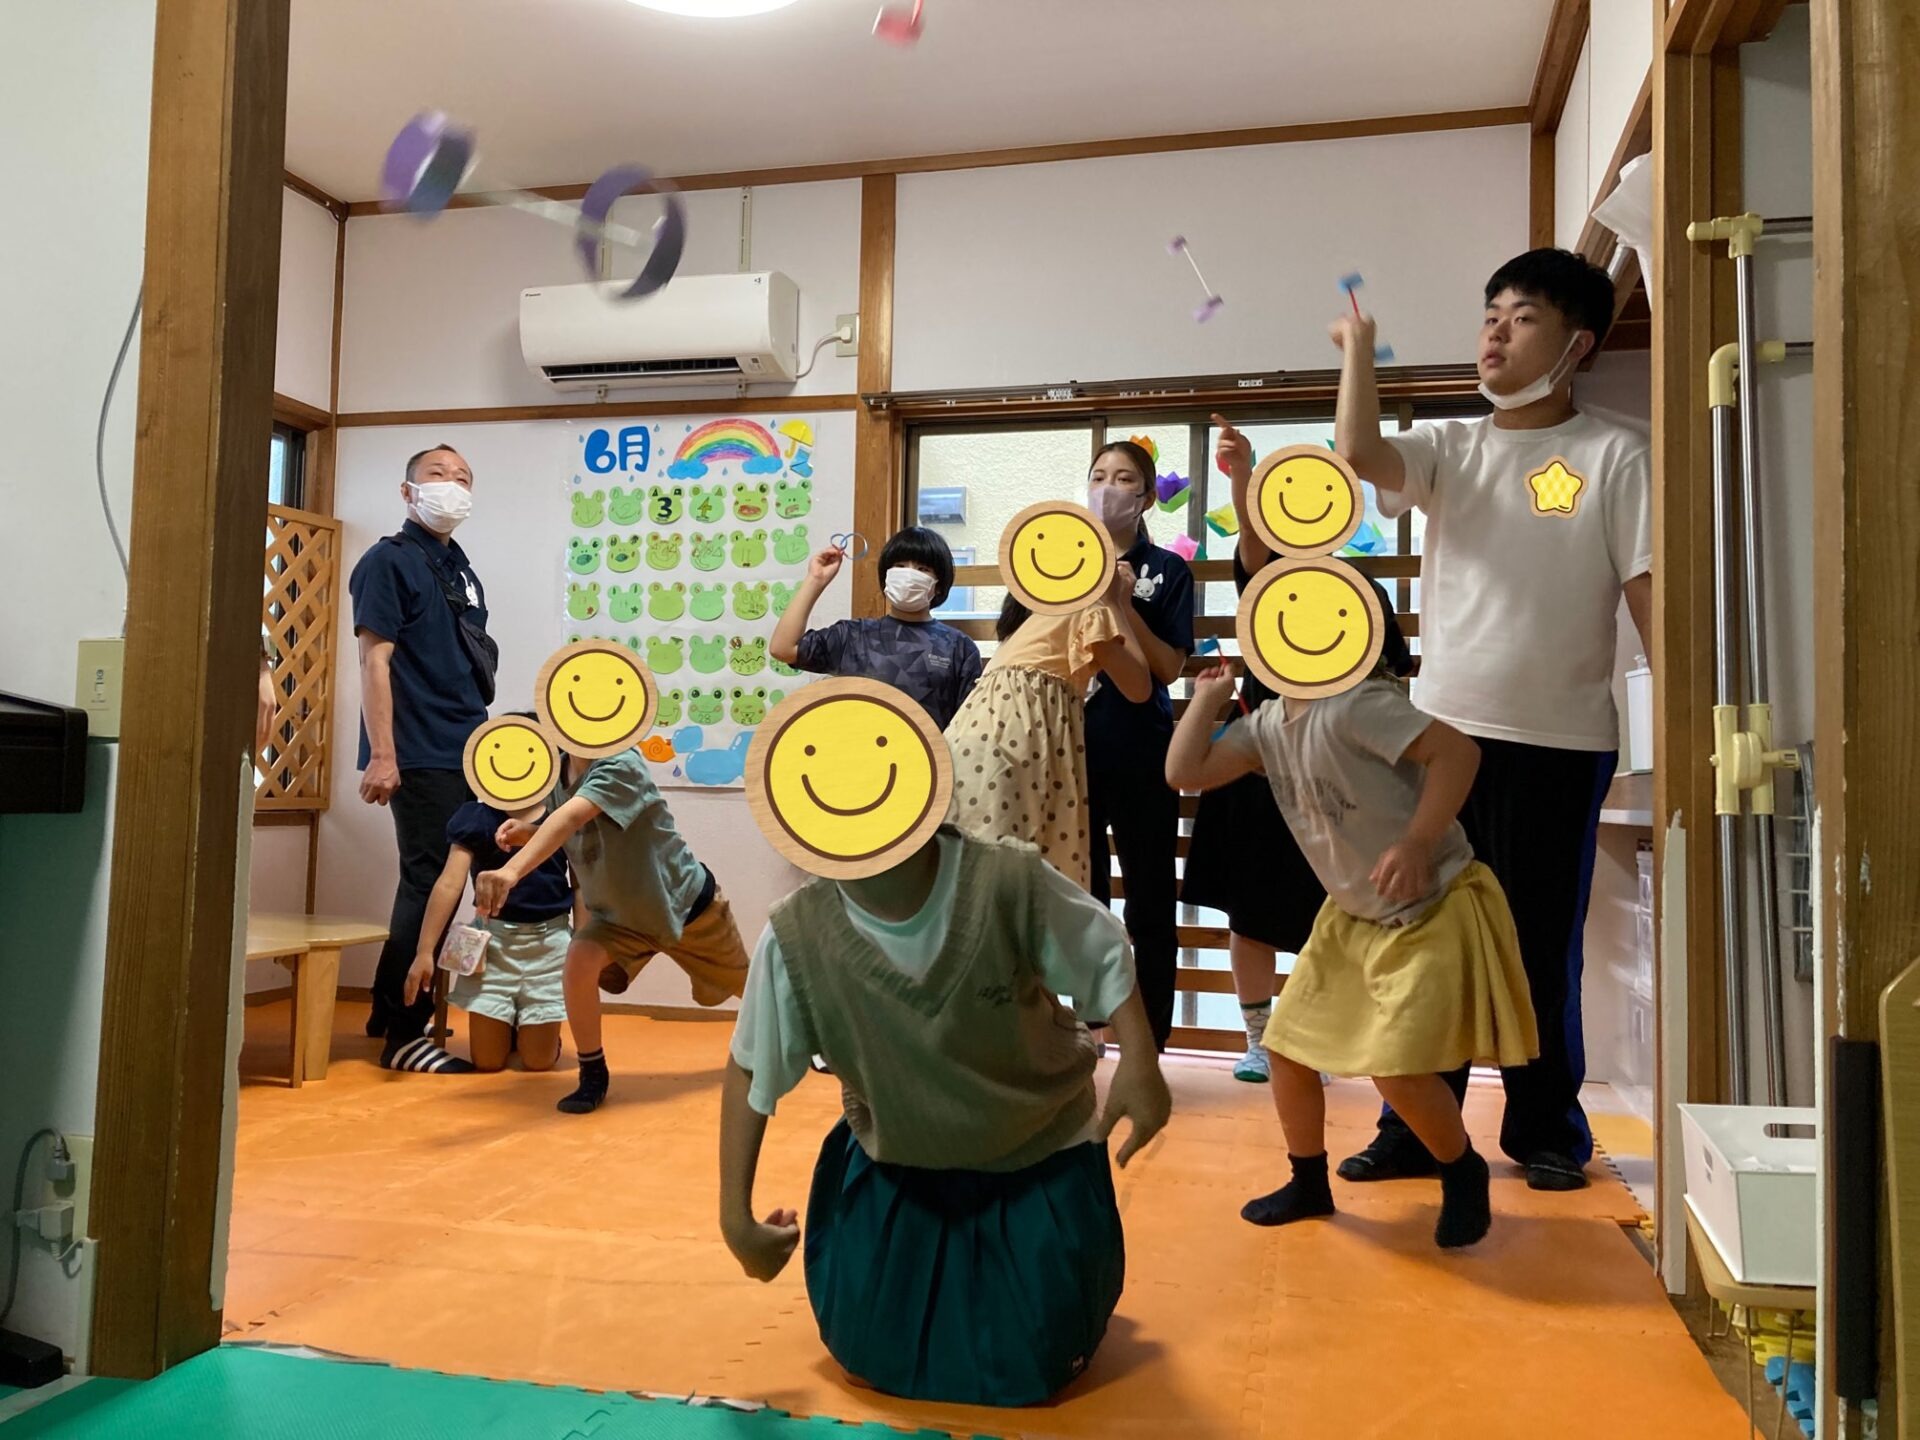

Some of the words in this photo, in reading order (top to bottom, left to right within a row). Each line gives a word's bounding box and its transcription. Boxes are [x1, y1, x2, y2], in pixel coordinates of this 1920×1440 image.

[584, 425, 650, 473] 6月
[657, 497, 672, 518] 3
[697, 496, 712, 519] 4
